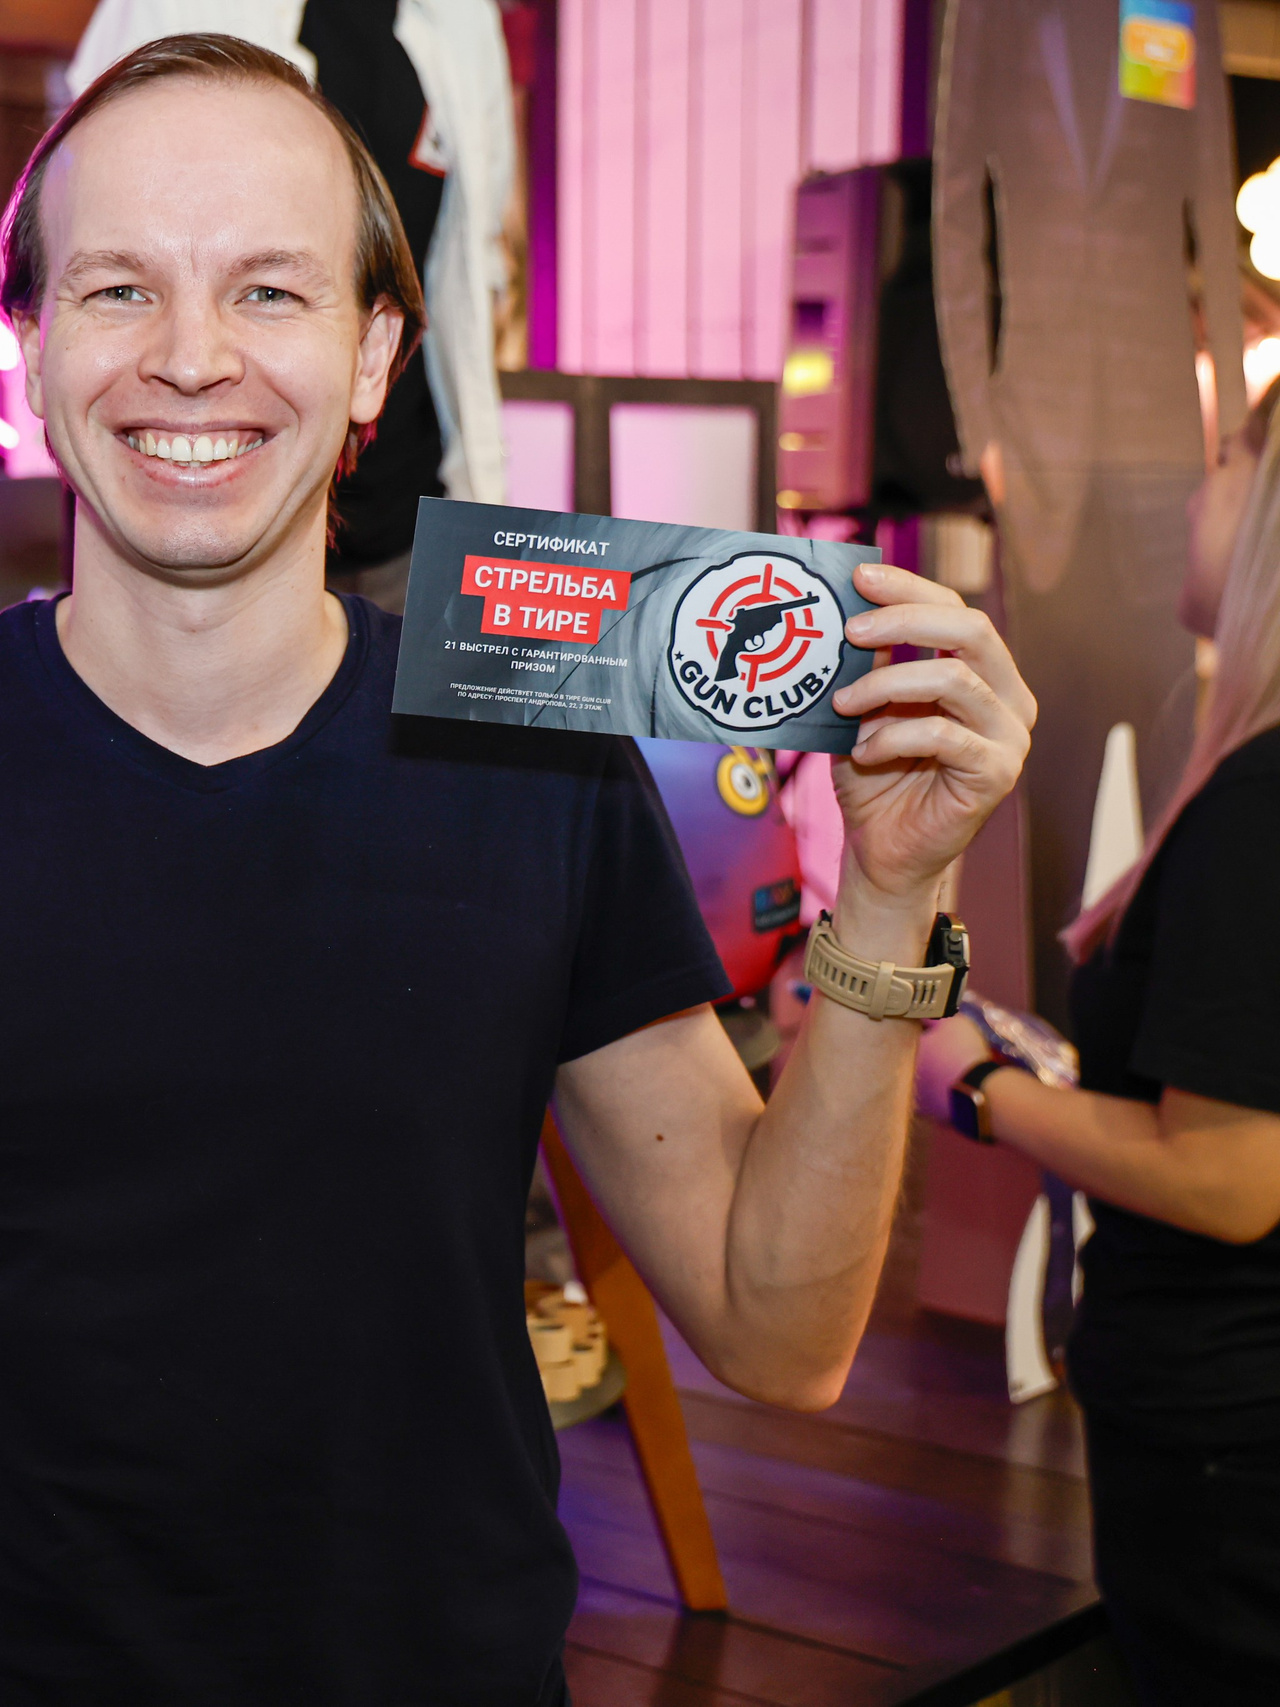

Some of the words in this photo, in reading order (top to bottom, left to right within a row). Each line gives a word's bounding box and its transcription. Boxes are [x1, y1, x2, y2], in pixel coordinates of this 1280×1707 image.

[493, 531, 610, 557] СЕРТИФИКАТ
[474, 565, 617, 601] СТРЕЛЬБА
[493, 604, 511, 626] В
[519, 606, 591, 635] ТИРЕ
[444, 640, 456, 650] 21
[459, 642, 509, 656] ВЫСТРЕЛ
[511, 647, 519, 657] С
[521, 649, 628, 667] ГАРАНТИРОВАННЫМ
[510, 660, 556, 674] ПРИЗОМ
[450, 682, 497, 693] ПРЕДЛОЖЕНИЕ
[497, 687, 534, 697] ДЕЙСТВУЕТ
[534, 691, 559, 700] ТОЛЬКО
[565, 694, 581, 702] ТИРЕ
[467, 692, 494, 700] АДРЕСУ:
[494, 695, 528, 704] ПРОСПЕКТ
[528, 698, 568, 709] АНДРОПОВА,
[568, 702, 578, 710] 22,
[584, 703, 603, 711] ЭТАЖ
[679, 660, 738, 715] GUN
[743, 672, 824, 719] CLUB
